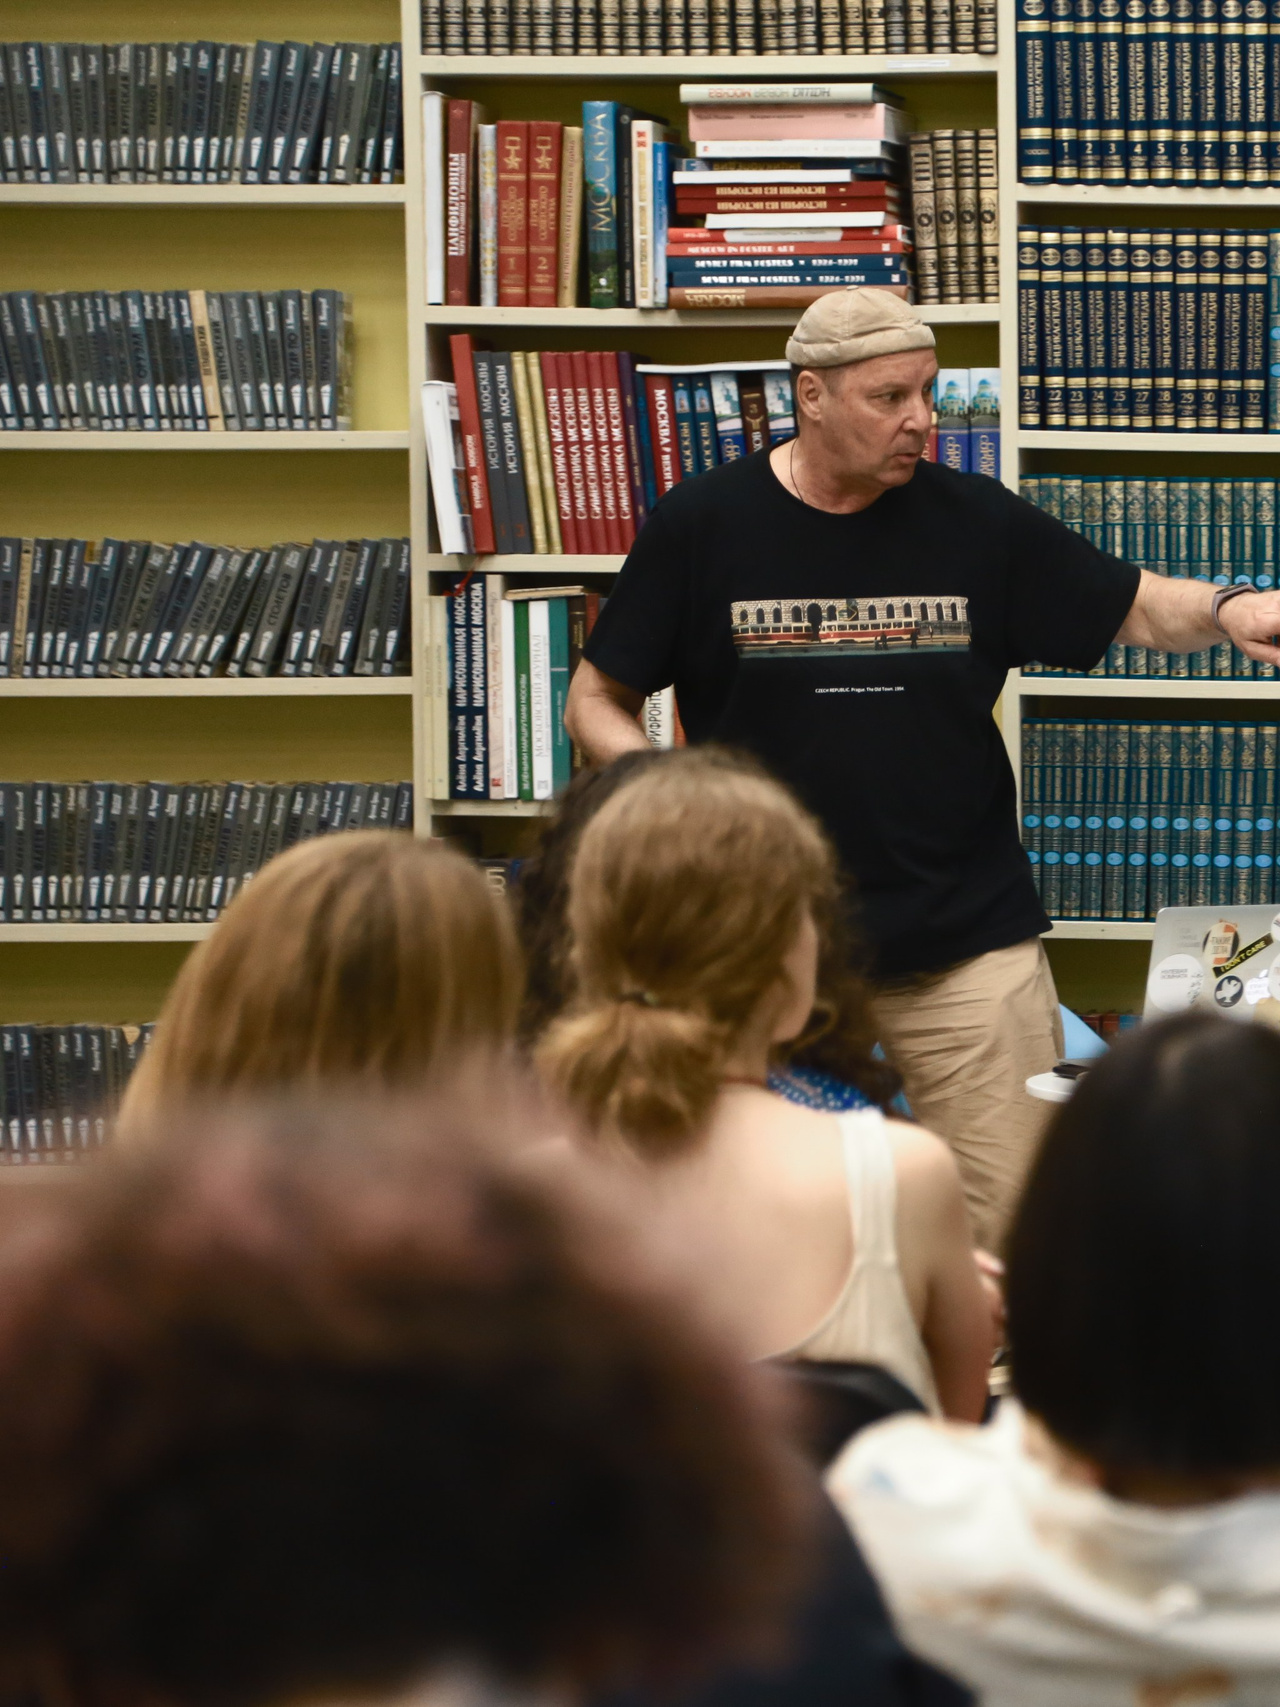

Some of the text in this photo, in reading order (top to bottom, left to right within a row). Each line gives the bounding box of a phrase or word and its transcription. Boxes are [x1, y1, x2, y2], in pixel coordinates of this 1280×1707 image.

[1063, 143, 1068, 152] 1
[1085, 143, 1093, 153] 2
[1108, 143, 1116, 153] 3
[1134, 144, 1142, 154] 4
[1157, 143, 1165, 154] 5
[1180, 144, 1187, 154] 6
[1204, 144, 1212, 154] 7
[1229, 144, 1238, 155] 8
[1253, 144, 1261, 155] 8
[588, 112, 612, 232] МОСКВА
[448, 153, 460, 256] ПАНФИЛОВЦЫ
[507, 257, 515, 270] 1
[538, 257, 548, 270] 2
[1023, 390, 1036, 399] 21
[1048, 391, 1062, 401] 22
[1070, 391, 1083, 401] 23
[1092, 391, 1104, 401] 24
[1113, 391, 1126, 401] 25
[1135, 392, 1149, 402] 27
[1180, 393, 1193, 404] 29
[1201, 392, 1215, 402] 30
[1225, 393, 1236, 404] 31
[1247, 393, 1260, 403] 32
[477, 362, 498, 470] ИСТОРИЯ МОСКВЫ
[496, 366, 518, 474] ИСТОРИЯ МОСКВЫ
[654, 389, 673, 480] МОСКВА ВЕХИ
[548, 388, 571, 519] СИМВОЛИКА МОСКВЫ
[563, 388, 587, 519] СИМВОЛИКА МОСКВЫ
[577, 388, 602, 519] СИМВОЛИКА МОСКВЫ
[593, 388, 616, 519] СИМВОЛИКА МОСКВЫ
[607, 388, 631, 519] СИМВОЛИКА МОСКВЫ
[680, 422, 694, 473] МОСКВЫ
[267, 573, 292, 627] СТОЛЕТОВ
[471, 583, 483, 625] МОСКВА
[455, 628, 467, 707] НАРИСОВАННАЯ
[472, 628, 484, 707] НАРИСОВАННАЯ
[520, 674, 528, 704] МОСКВЫ
[532, 634, 544, 757] МОСКОВСКИЙ ЖУРНАЛ
[520, 704, 529, 752] МАРШРУТАМИ
[1225, 954, 1246, 970] DON'T
[1246, 940, 1266, 956] CARE
